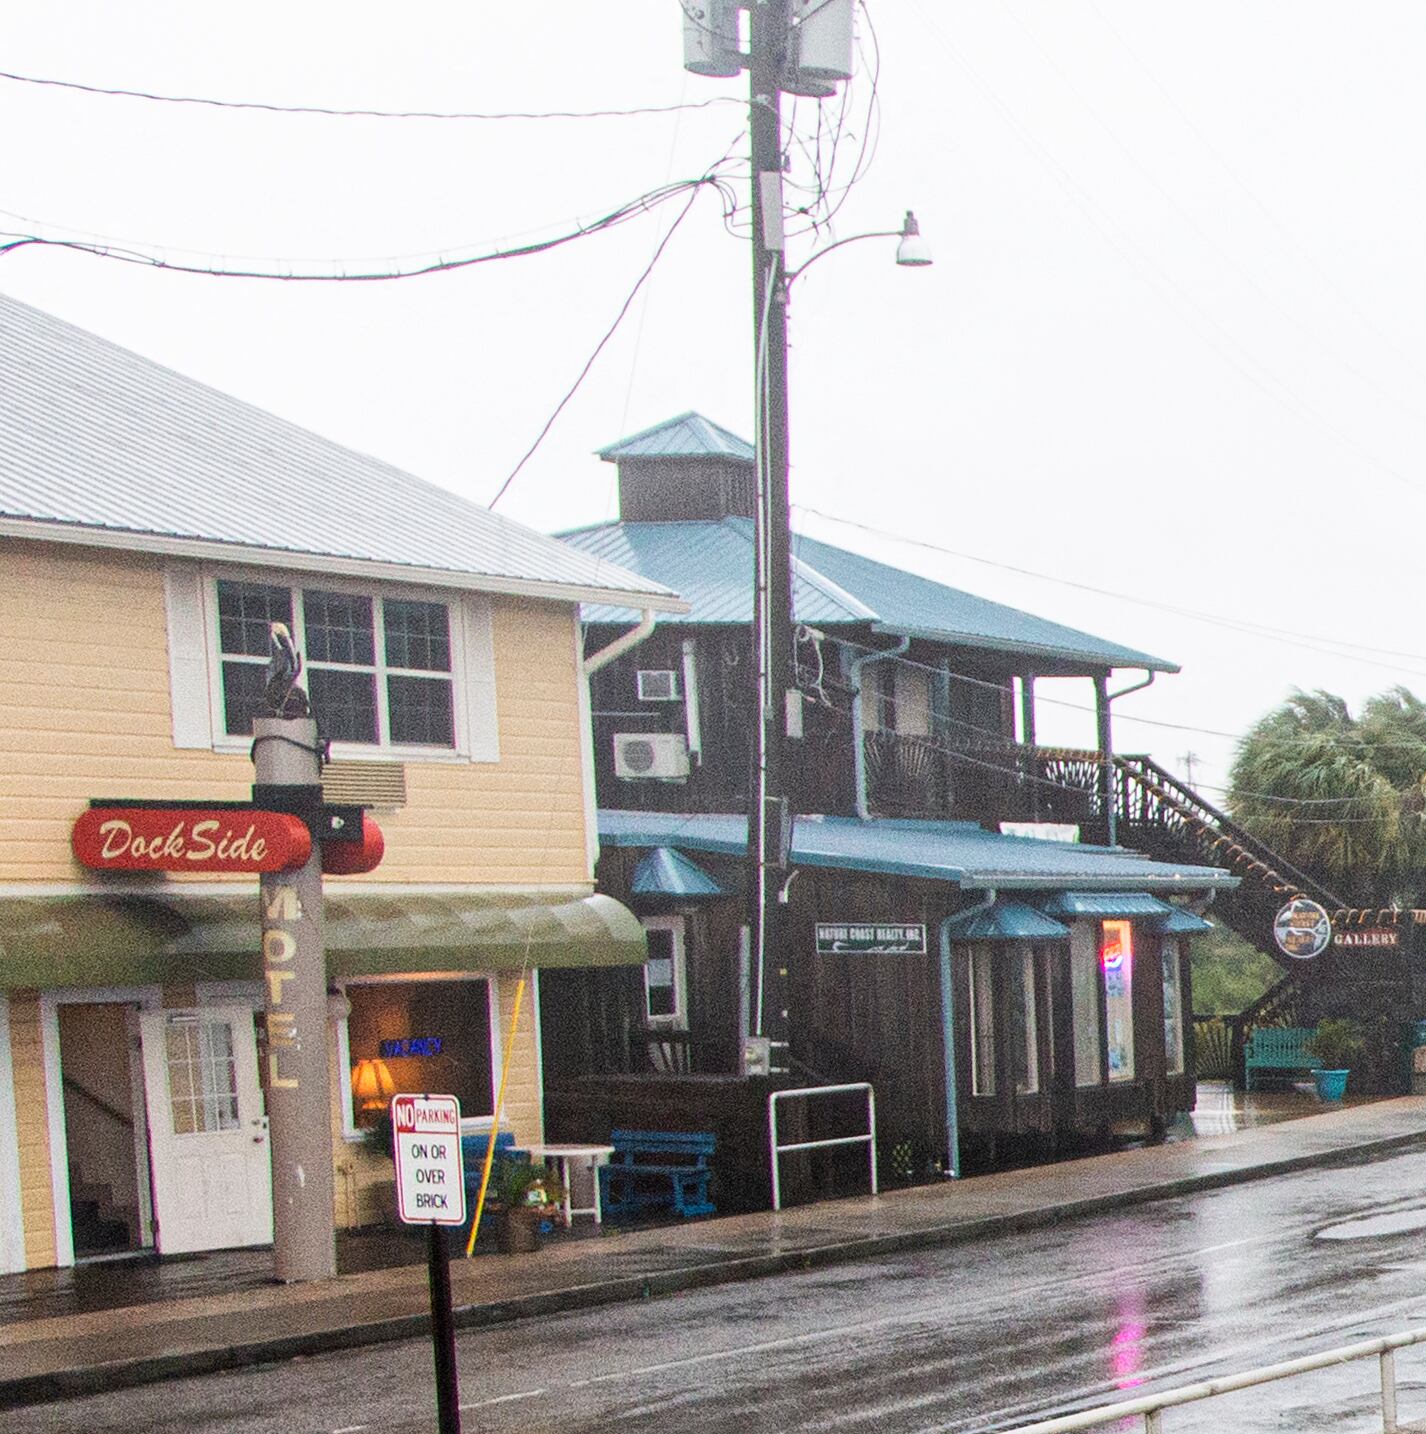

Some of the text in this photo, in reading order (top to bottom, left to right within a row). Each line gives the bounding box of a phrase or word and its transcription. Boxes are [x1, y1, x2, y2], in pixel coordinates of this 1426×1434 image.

[99, 819, 268, 862] DockSide
[1334, 933, 1398, 945] GALLERY
[263, 886, 302, 1088] MOTEL
[396, 1104, 455, 1129] NO PARKING
[411, 1144, 447, 1159] ON OR
[416, 1169, 445, 1184] OVER
[416, 1193, 448, 1209] BRICK
